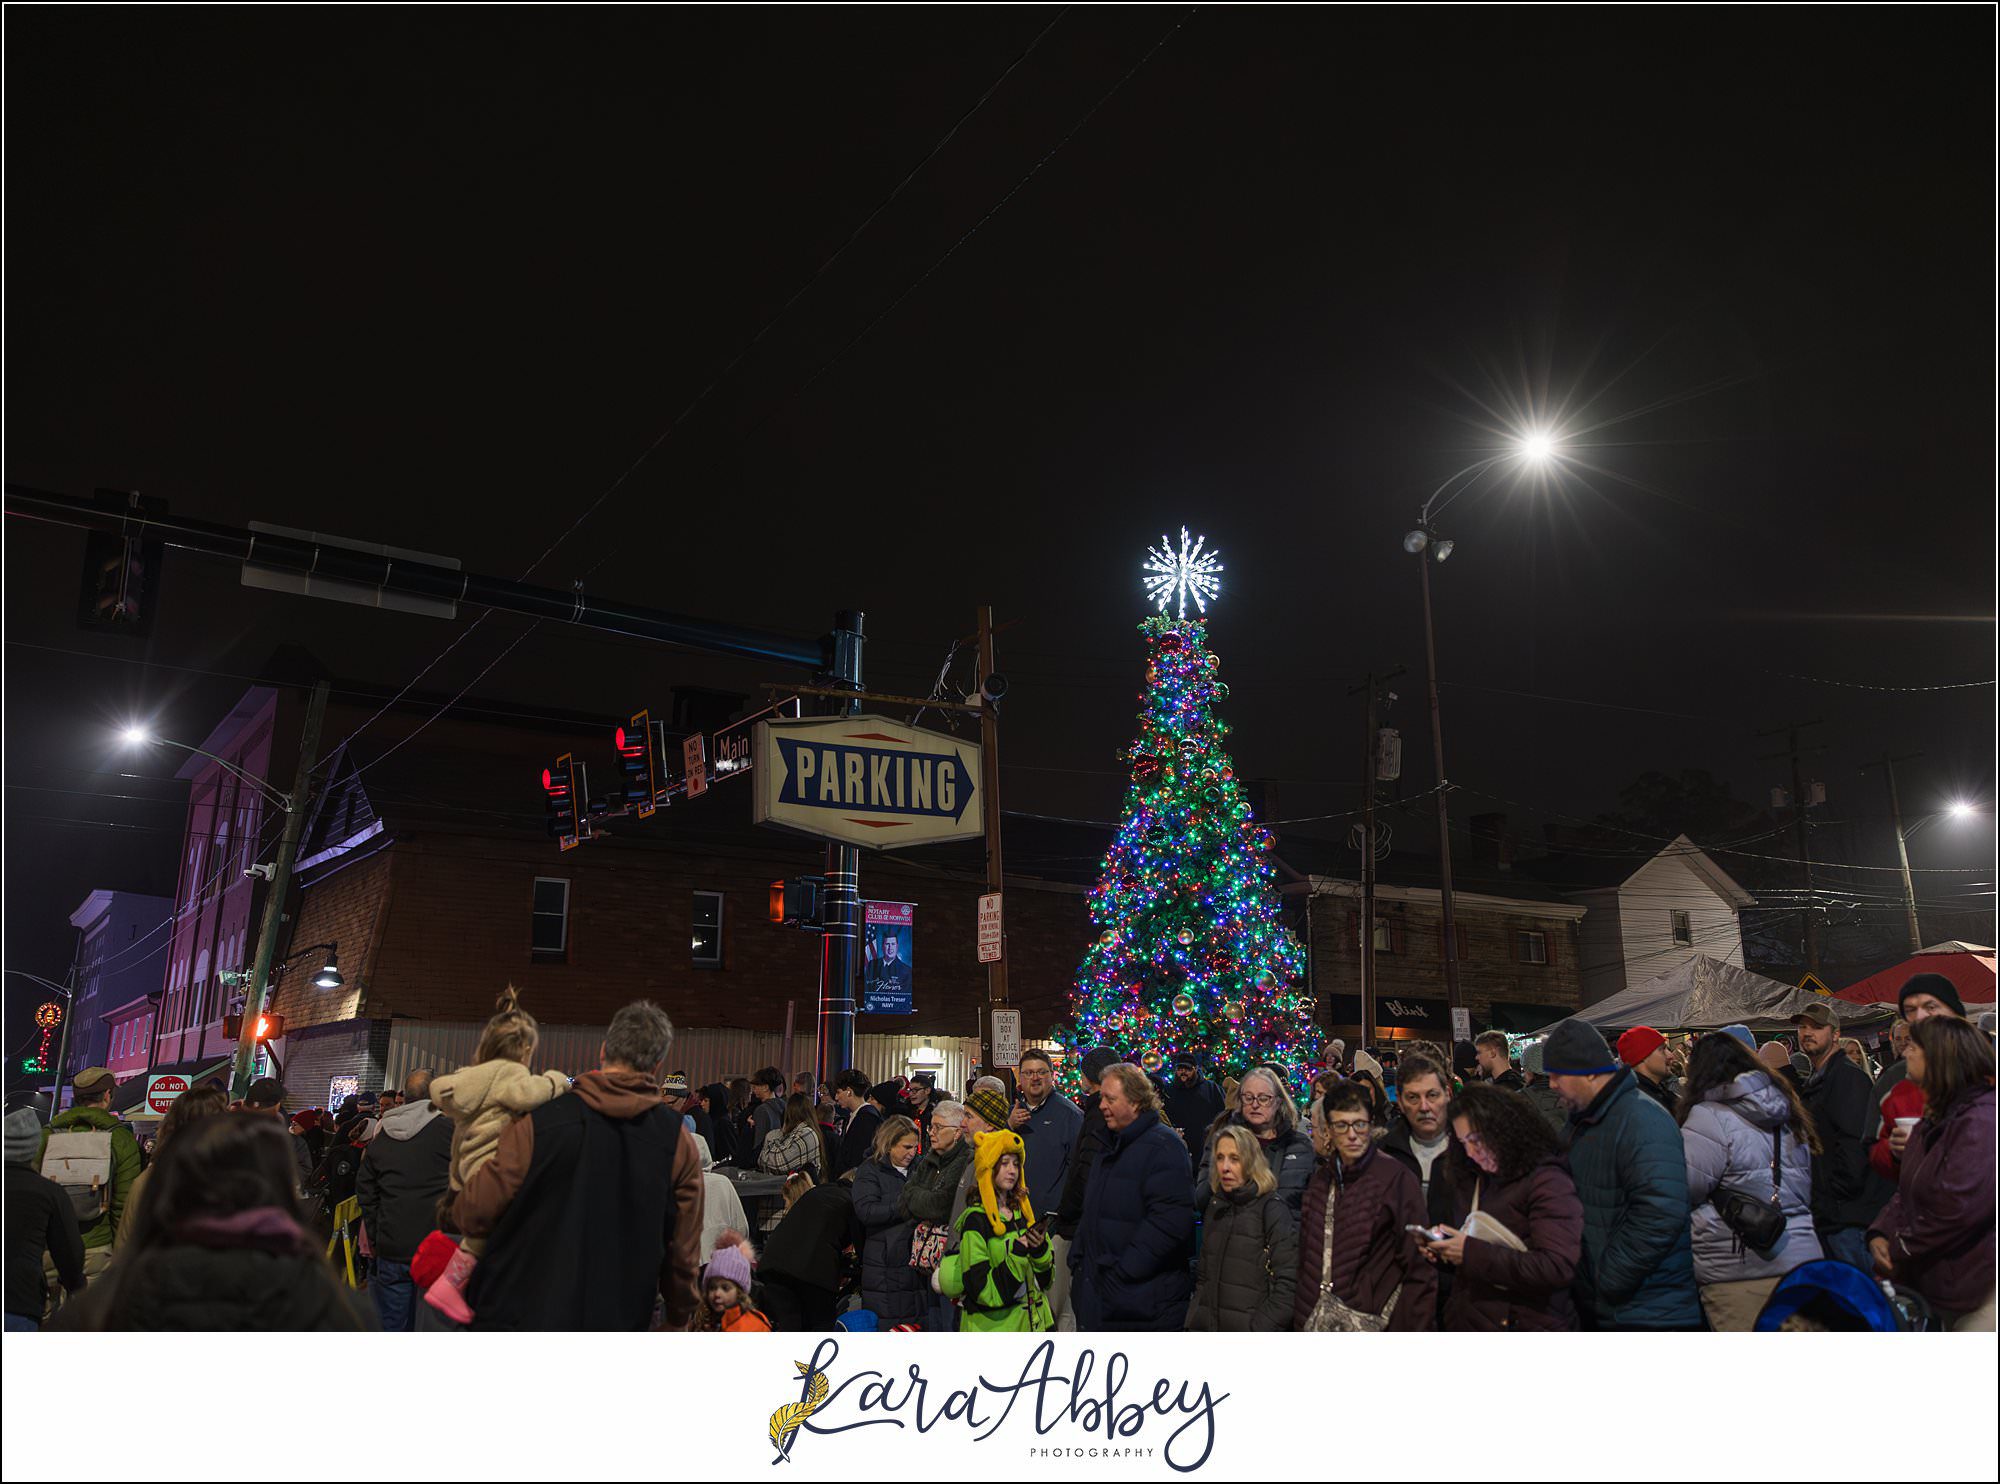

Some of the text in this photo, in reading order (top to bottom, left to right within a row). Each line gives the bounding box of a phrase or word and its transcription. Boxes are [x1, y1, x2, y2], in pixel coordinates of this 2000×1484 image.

[688, 740, 698, 753] NO
[720, 735, 749, 760] Main
[688, 764, 703, 778] ON RED
[796, 746, 956, 812] PARKING
[986, 897, 994, 909] NO
[980, 910, 1000, 922] PARKING
[996, 1015, 1016, 1024] TICKET
[1000, 1025, 1011, 1033] BOX
[997, 1043, 1017, 1051] POLICE
[995, 1052, 1019, 1061] STATION
